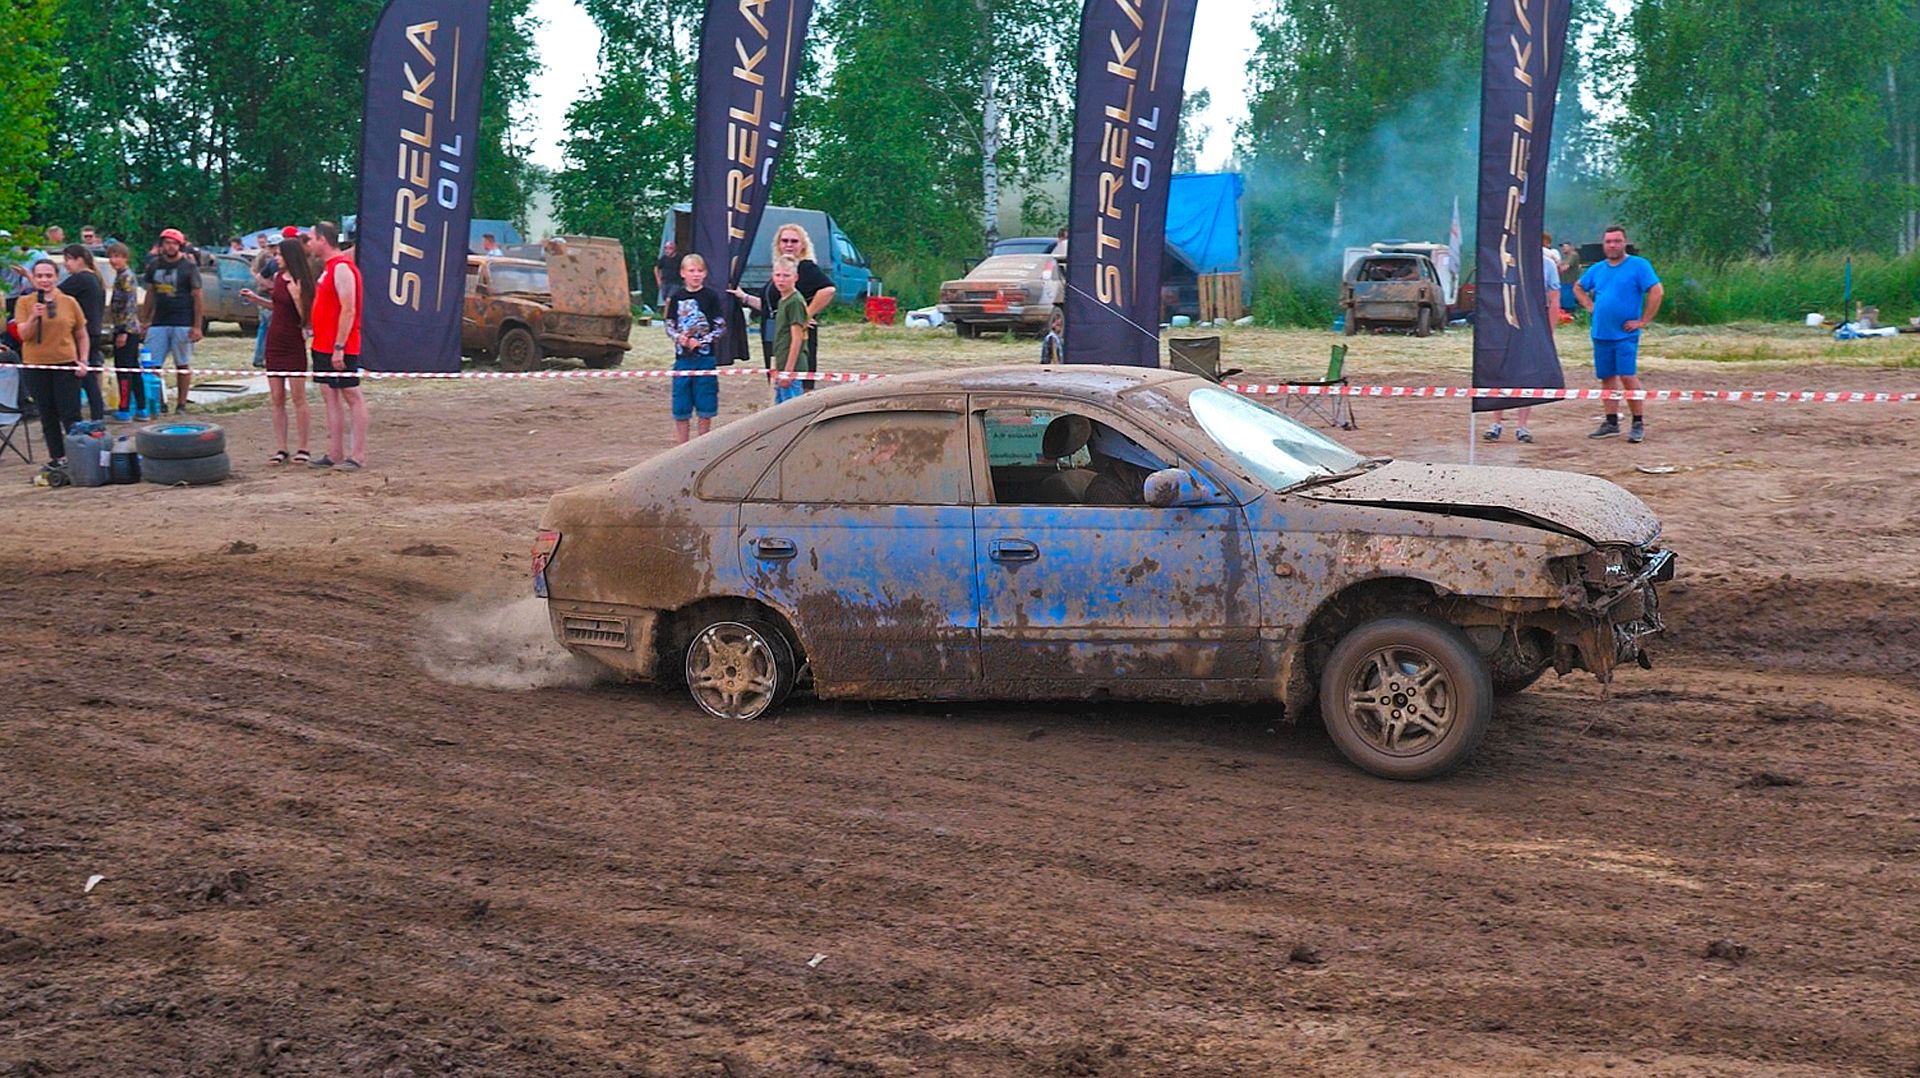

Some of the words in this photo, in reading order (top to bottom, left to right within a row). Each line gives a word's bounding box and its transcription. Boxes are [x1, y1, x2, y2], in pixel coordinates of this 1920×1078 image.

[389, 20, 439, 312] STRELKA
[437, 134, 462, 210] OIL
[1131, 106, 1160, 191] OIL
